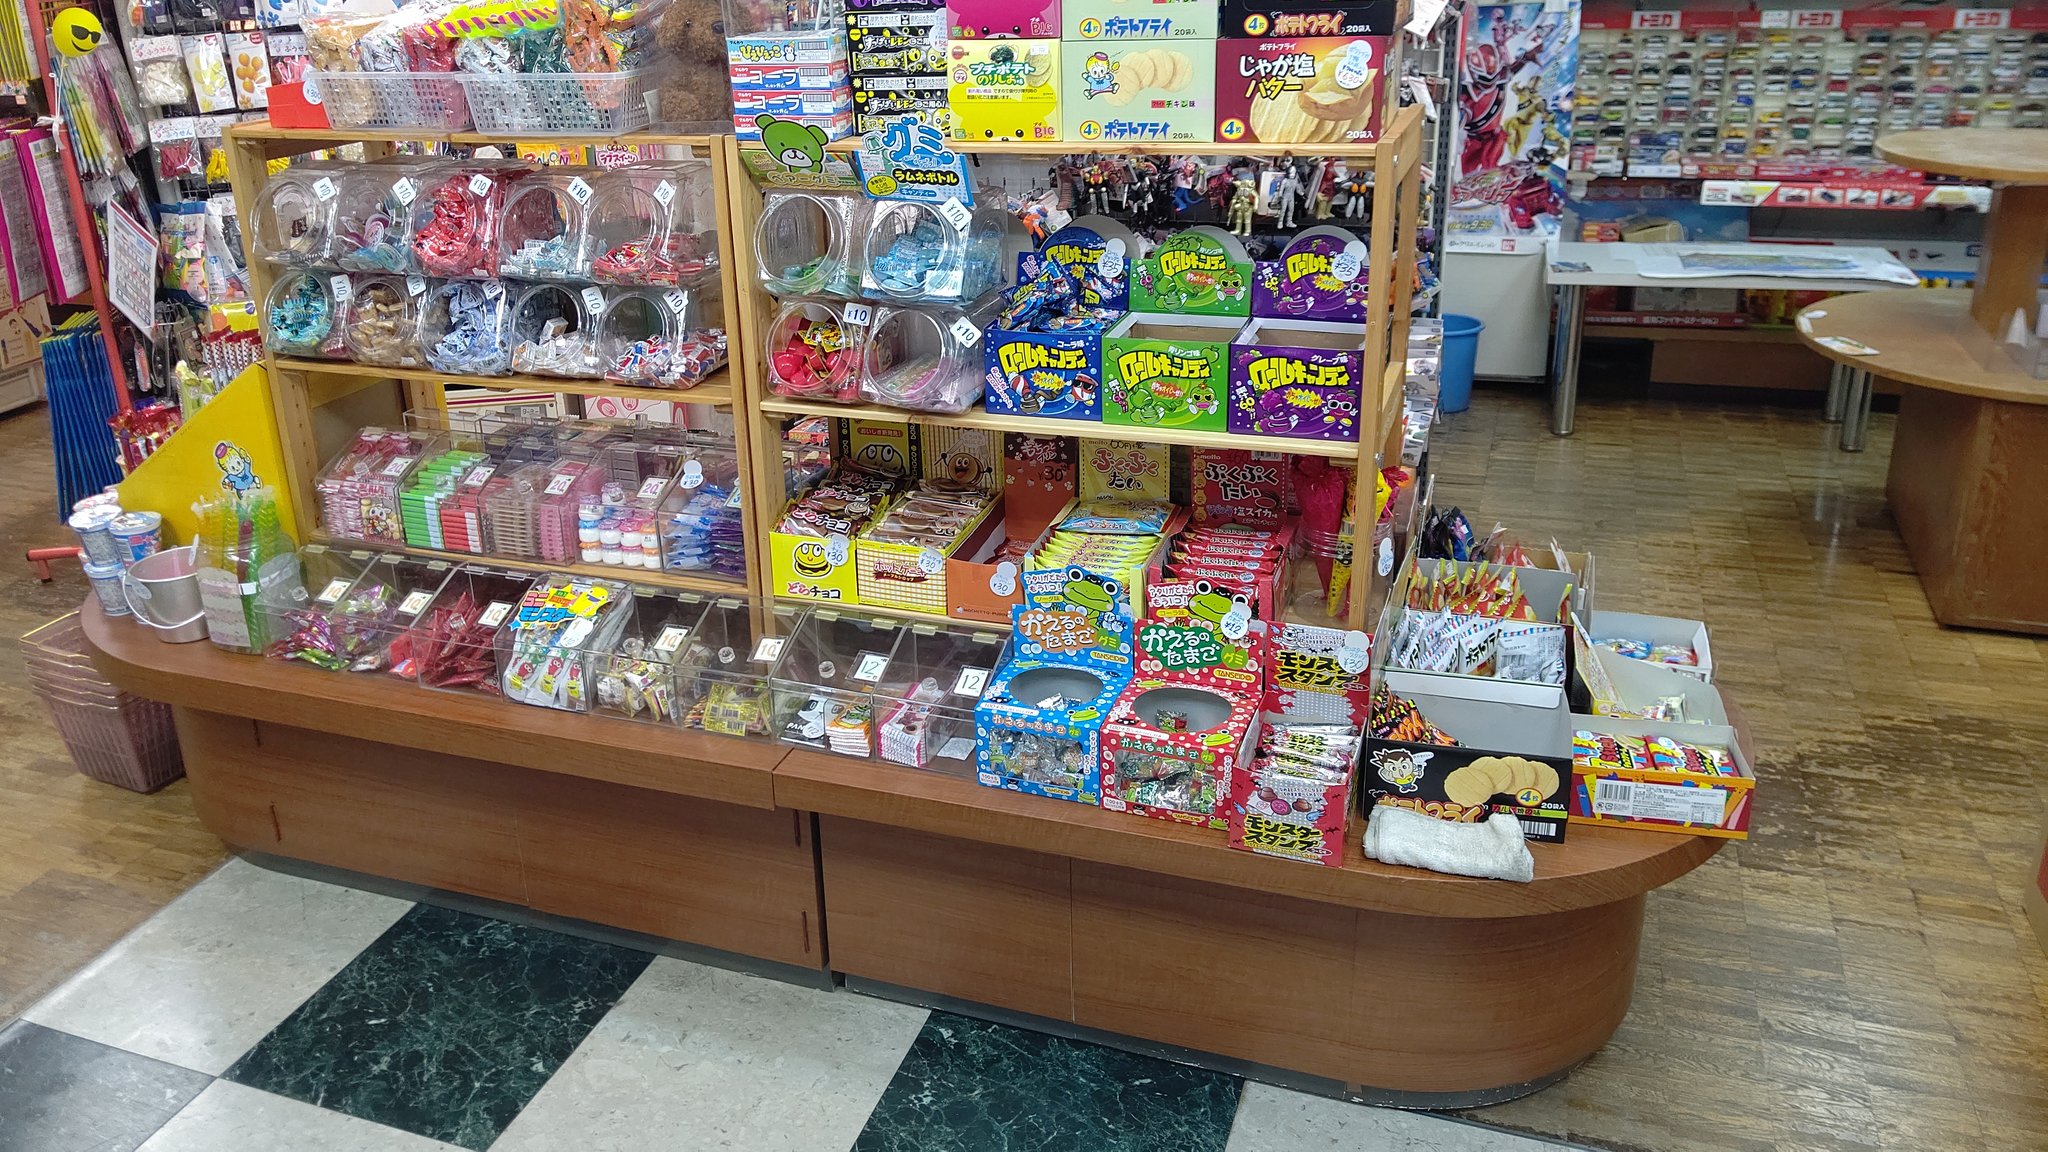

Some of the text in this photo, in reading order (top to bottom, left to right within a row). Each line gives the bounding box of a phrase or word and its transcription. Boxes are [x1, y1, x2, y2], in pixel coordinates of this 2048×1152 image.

[1105, 16, 1173, 38] ポテトフライ
[1274, 13, 1346, 35] ポテトフライ
[1346, 25, 1372, 33] 20袋入
[1259, 43, 1296, 51] ポテトフライ
[969, 62, 1036, 76] プチポテト
[1239, 53, 1316, 78] じゃが塩
[750, 68, 797, 86] コーラ
[1244, 77, 1303, 100] バター
[753, 94, 800, 111] コーラ
[1034, 126, 1056, 138] BIG
[1104, 119, 1171, 140] ポテトフライ
[1346, 130, 1374, 139] 20袋入
[882, 116, 956, 167] グミ
[600, 153, 638, 164] ラブスイーツ
[894, 171, 958, 183] ラムネボトル
[572, 182, 588, 199] ¥10
[901, 188, 936, 197] キャンディー
[946, 204, 965, 222] ¥10
[1101, 261, 1122, 274] ¥35
[1160, 250, 1227, 277] ロールキャンディ
[1335, 263, 1356, 277] ¥35
[667, 291, 683, 308] ¥10
[847, 309, 868, 322] ¥10
[957, 325, 975, 342] ¥10
[1057, 340, 1085, 348] コーラ味
[998, 342, 1088, 378] ロールキャンディ
[1311, 354, 1349, 365] グレープ味
[1118, 351, 1211, 391] ロールキャンディ
[1248, 357, 1351, 392] ロールキャンディ
[1036, 451, 1058, 464] プリン
[1091, 447, 1160, 477] ぷくぷく
[388, 463, 404, 473] 20
[1204, 463, 1280, 485] ぷくぷく
[472, 471, 485, 482] 20
[1107, 471, 1144, 491] たい
[553, 480, 566, 492] 20
[643, 483, 658, 494] 20
[1218, 481, 1262, 501] たい
[792, 508, 852, 532] どらチョコ
[1233, 507, 1278, 518] 塩スイカ味
[327, 585, 341, 599] 10
[787, 582, 842, 599] どらチョコ
[405, 597, 420, 610] 10
[486, 608, 501, 621] 10
[519, 607, 577, 623] モンスター
[1020, 613, 1086, 637] かえるの
[1224, 621, 1243, 635] ¥12
[662, 630, 677, 646] 10
[1041, 627, 1095, 649] たまご
[1098, 635, 1118, 648] グミ
[1141, 628, 1211, 652] かえるの
[1161, 643, 1219, 667] たまご
[1223, 652, 1244, 666] グミ
[859, 660, 879, 674] 12
[1344, 657, 1364, 670] ¥30
[961, 674, 980, 690] 12
[1278, 667, 1359, 689] スタンプ
[1541, 802, 1566, 810] 20袋入
[1246, 815, 1322, 839] モンスター
[1244, 830, 1320, 851] スタンプ
